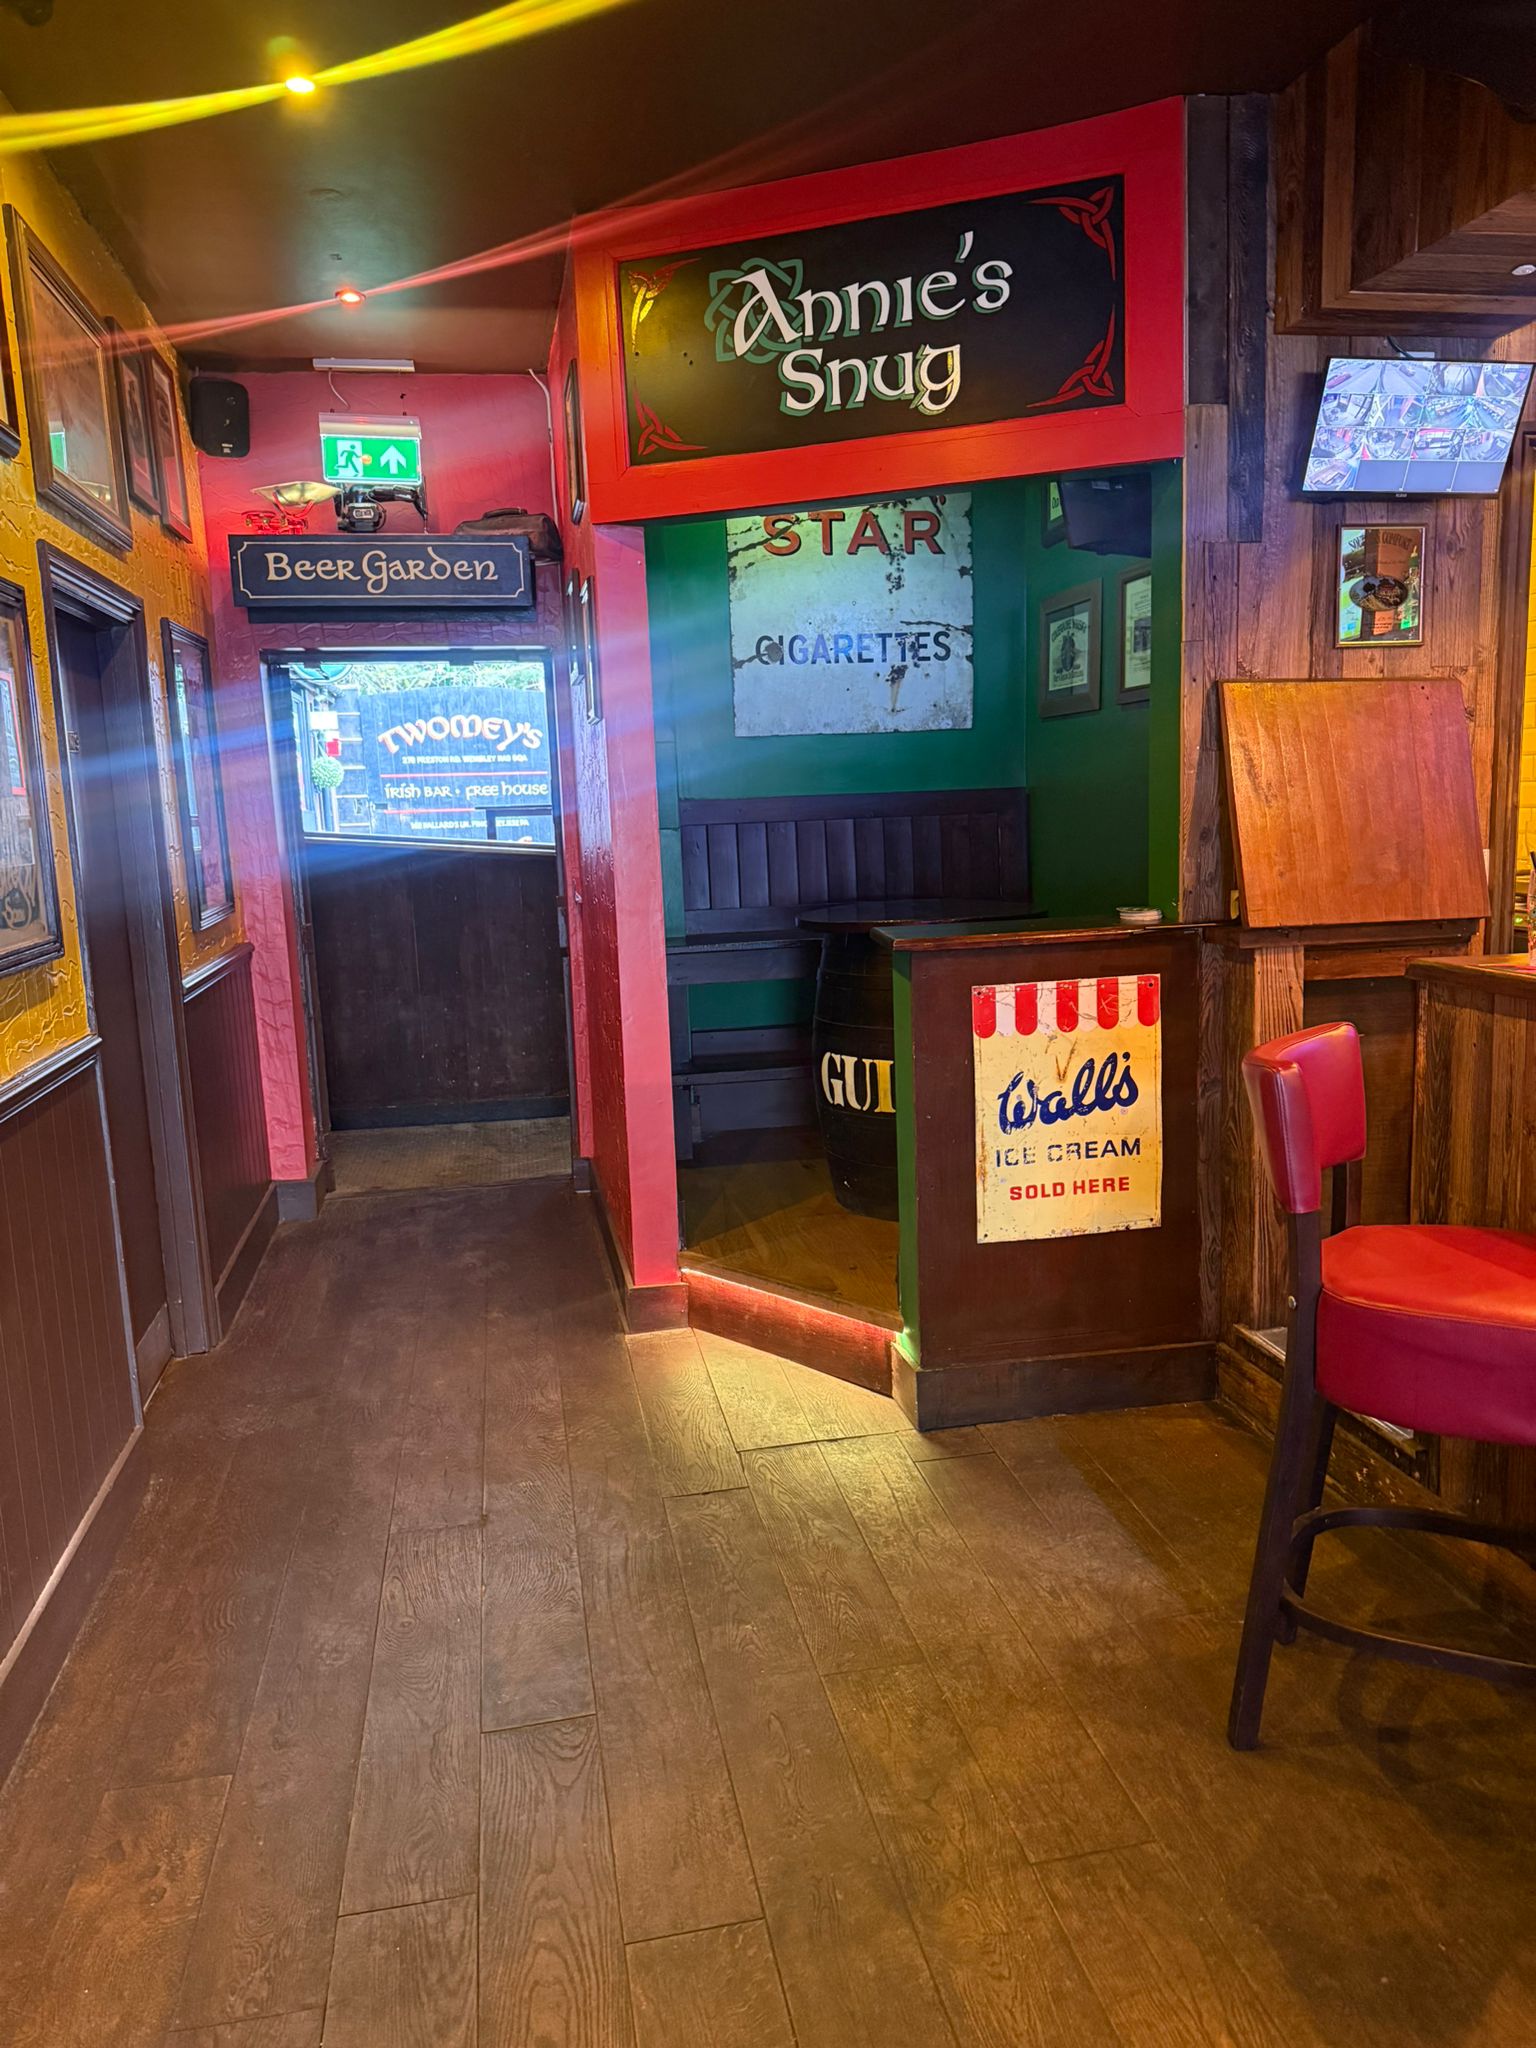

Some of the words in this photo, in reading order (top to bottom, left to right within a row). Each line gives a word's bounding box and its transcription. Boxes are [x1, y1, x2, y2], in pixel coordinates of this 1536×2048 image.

[732, 230, 1013, 357] Annie's
[780, 343, 960, 416] Snug
[755, 631, 952, 665] CIGARETTES
[821, 1051, 896, 1113] GUI
[997, 1051, 1139, 1135] Wall's
[996, 1146, 1036, 1168] ICE
[1047, 1137, 1140, 1163] CREAM
[1009, 1182, 1065, 1201] SOLD
[1073, 1176, 1130, 1197] HERE
